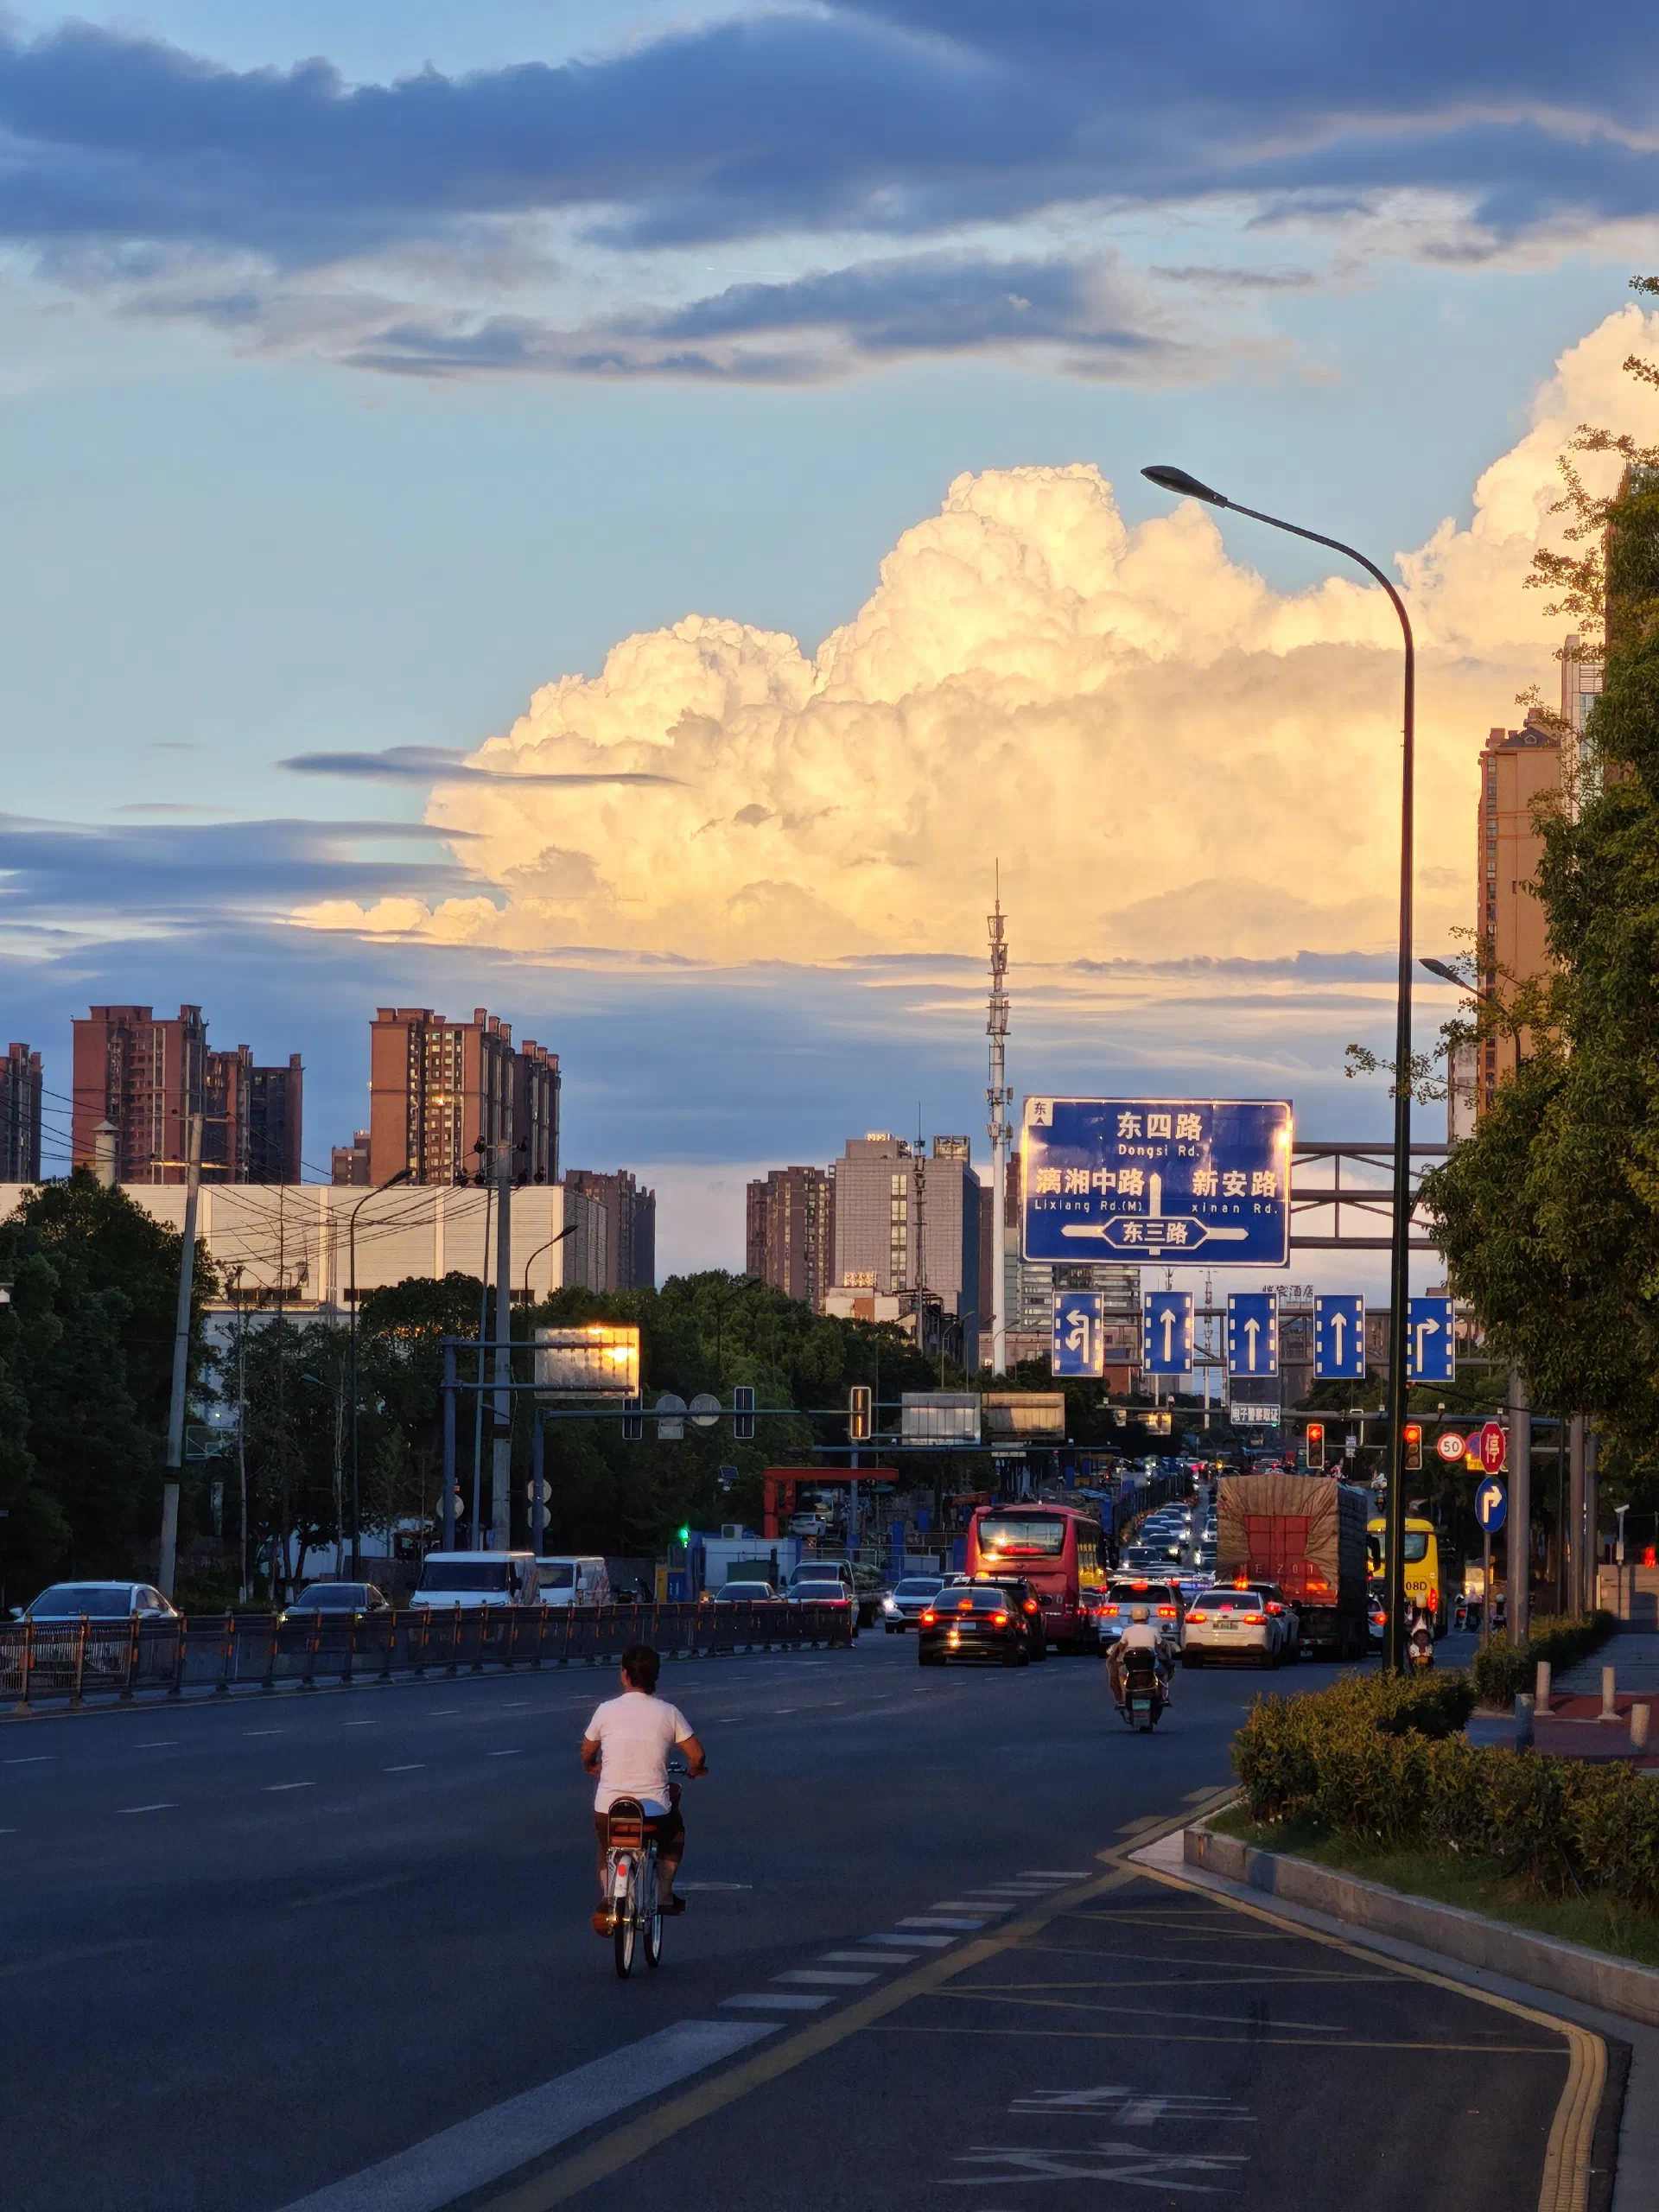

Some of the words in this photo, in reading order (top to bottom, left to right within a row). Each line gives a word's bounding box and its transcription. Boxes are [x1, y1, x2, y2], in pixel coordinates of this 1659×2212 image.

[1034, 1102, 1046, 1116] 东
[1116, 1111, 1203, 1141] 东四路
[1118, 1143, 1168, 1160] Dongsi
[1178, 1145, 1199, 1157] Rd.
[1192, 1169, 1277, 1198] 新安路
[1034, 1198, 1090, 1213] Lixiang
[1253, 1203, 1278, 1214] Rd.
[1122, 1220, 1188, 1245] 东三路
[1443, 1440, 1460, 1452] 50
[1485, 1433, 1500, 1464] 停
[1405, 1581, 1427, 1591] 08D
